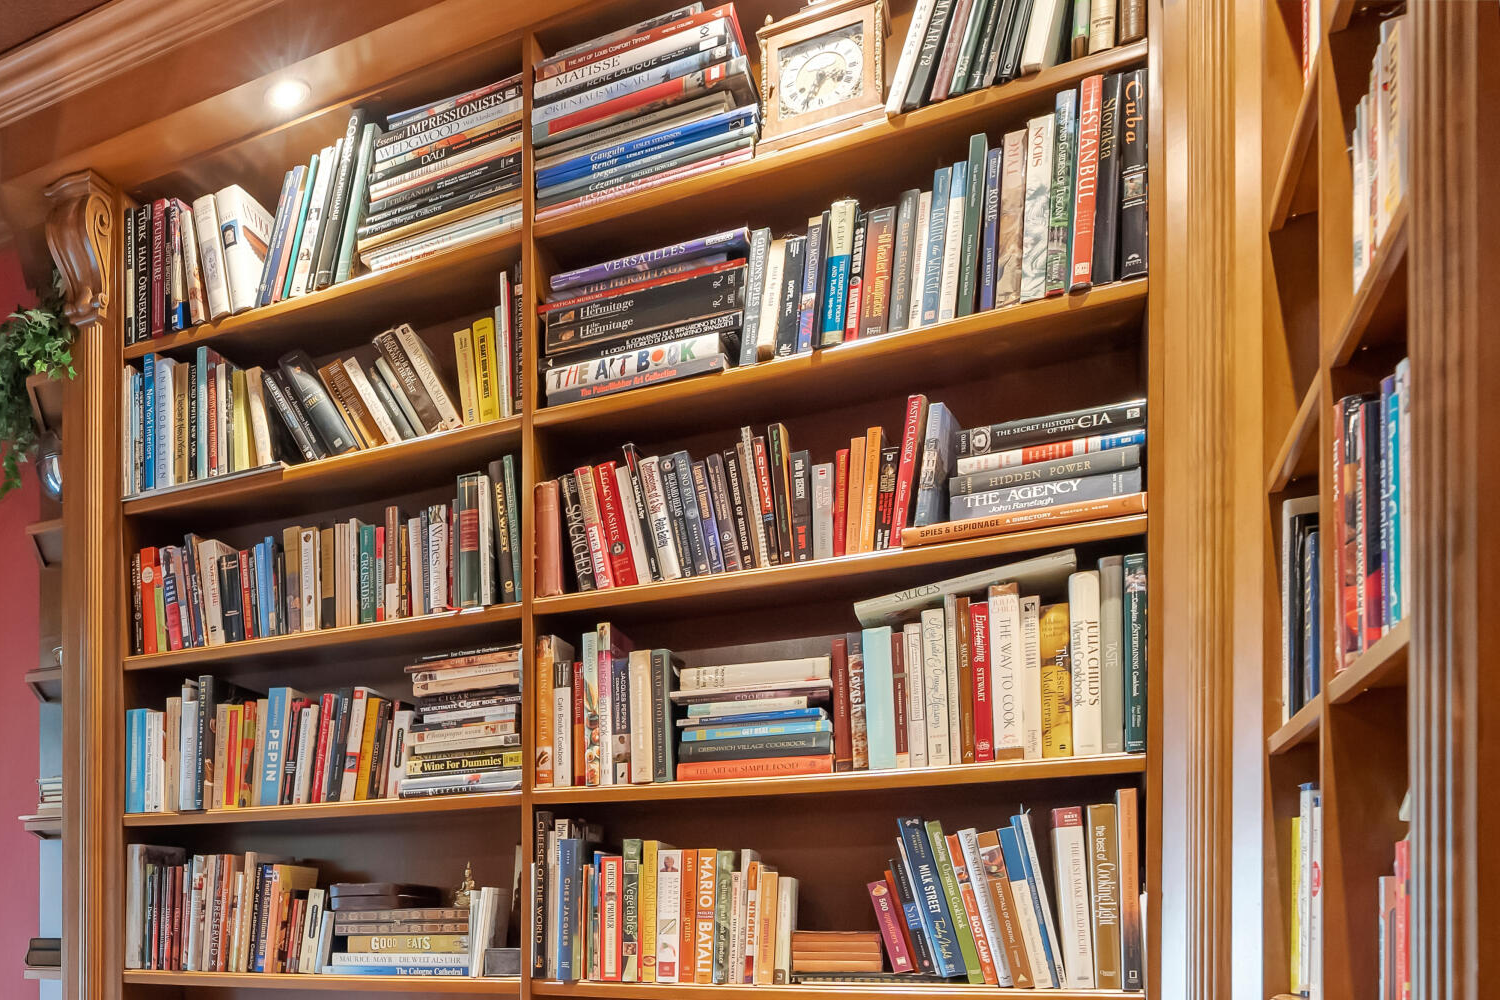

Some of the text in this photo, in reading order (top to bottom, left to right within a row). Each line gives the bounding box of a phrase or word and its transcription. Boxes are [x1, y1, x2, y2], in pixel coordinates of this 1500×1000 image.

[555, 56, 620, 87] MATISSE
[614, 58, 658, 77] LALIQUE
[376, 132, 404, 147] Essential
[407, 91, 504, 137] IMPRESSIONISTS
[1125, 80, 1143, 145] Cuba
[379, 122, 460, 160] WEDGWOOD
[1100, 97, 1116, 160] Slovakia
[421, 149, 446, 165] DALI
[590, 147, 625, 162] Gauguin
[416, 205, 442, 218] Collector
[987, 188, 999, 222] ROME
[154, 221, 162, 281] FURNITURE
[603, 244, 687, 272] VERSAILLES
[896, 223, 909, 300] BURT REYNOLDS
[580, 299, 634, 318] Hermitage
[580, 318, 634, 338] Hermitage
[551, 339, 697, 389] THE ART BOOK
[996, 418, 1076, 437] THE SECRET HISTORY
[1078, 411, 1113, 429] CIA
[904, 425, 916, 464] CLASSICA
[682, 474, 690, 486] NO
[989, 460, 1091, 487] HIDDEN POWER
[600, 466, 612, 502] LEGACY
[607, 512, 620, 540] ASHES
[684, 488, 693, 504] EVIL
[963, 478, 1083, 508] THE AGENCY
[989, 502, 1012, 513] John
[920, 526, 943, 538] SPIES
[953, 518, 1001, 533] ESPIONAGE
[1012, 512, 1051, 523] DIRECTORY
[431, 523, 443, 566] Wines
[566, 505, 592, 577] SPYCATCHER
[361, 552, 370, 610] CRUSADES
[894, 583, 941, 603] SAUCES
[1086, 620, 1099, 655] JULIA
[1105, 640, 1118, 668] TASTE
[977, 668, 986, 702] STEWART
[999, 619, 1015, 728] THE WAY TO COOK
[1055, 646, 1070, 714] The Essential
[1073, 649, 1085, 707] Cookbook
[459, 700, 480, 708] Cigar
[600, 716, 608, 736] book
[266, 730, 280, 782] PEPIN
[765, 740, 806, 749] COOKBOOK
[423, 757, 502, 771] Wine For Dummies
[1095, 826, 1107, 838] the
[536, 821, 545, 944] CHEESES OF THE WORLD
[919, 864, 941, 914] MILK STREET
[623, 881, 637, 936] Vegetables
[697, 857, 714, 972] MARIO BATALI
[879, 898, 888, 911] 500
[907, 905, 918, 926] Salt
[211, 900, 220, 956] PRESERVED
[748, 901, 756, 945] PUMPKIN
[371, 936, 432, 951] GOOD EATS
[971, 915, 991, 963] BOOT CAMP
[395, 967, 463, 976] The Cologne Cathedral
